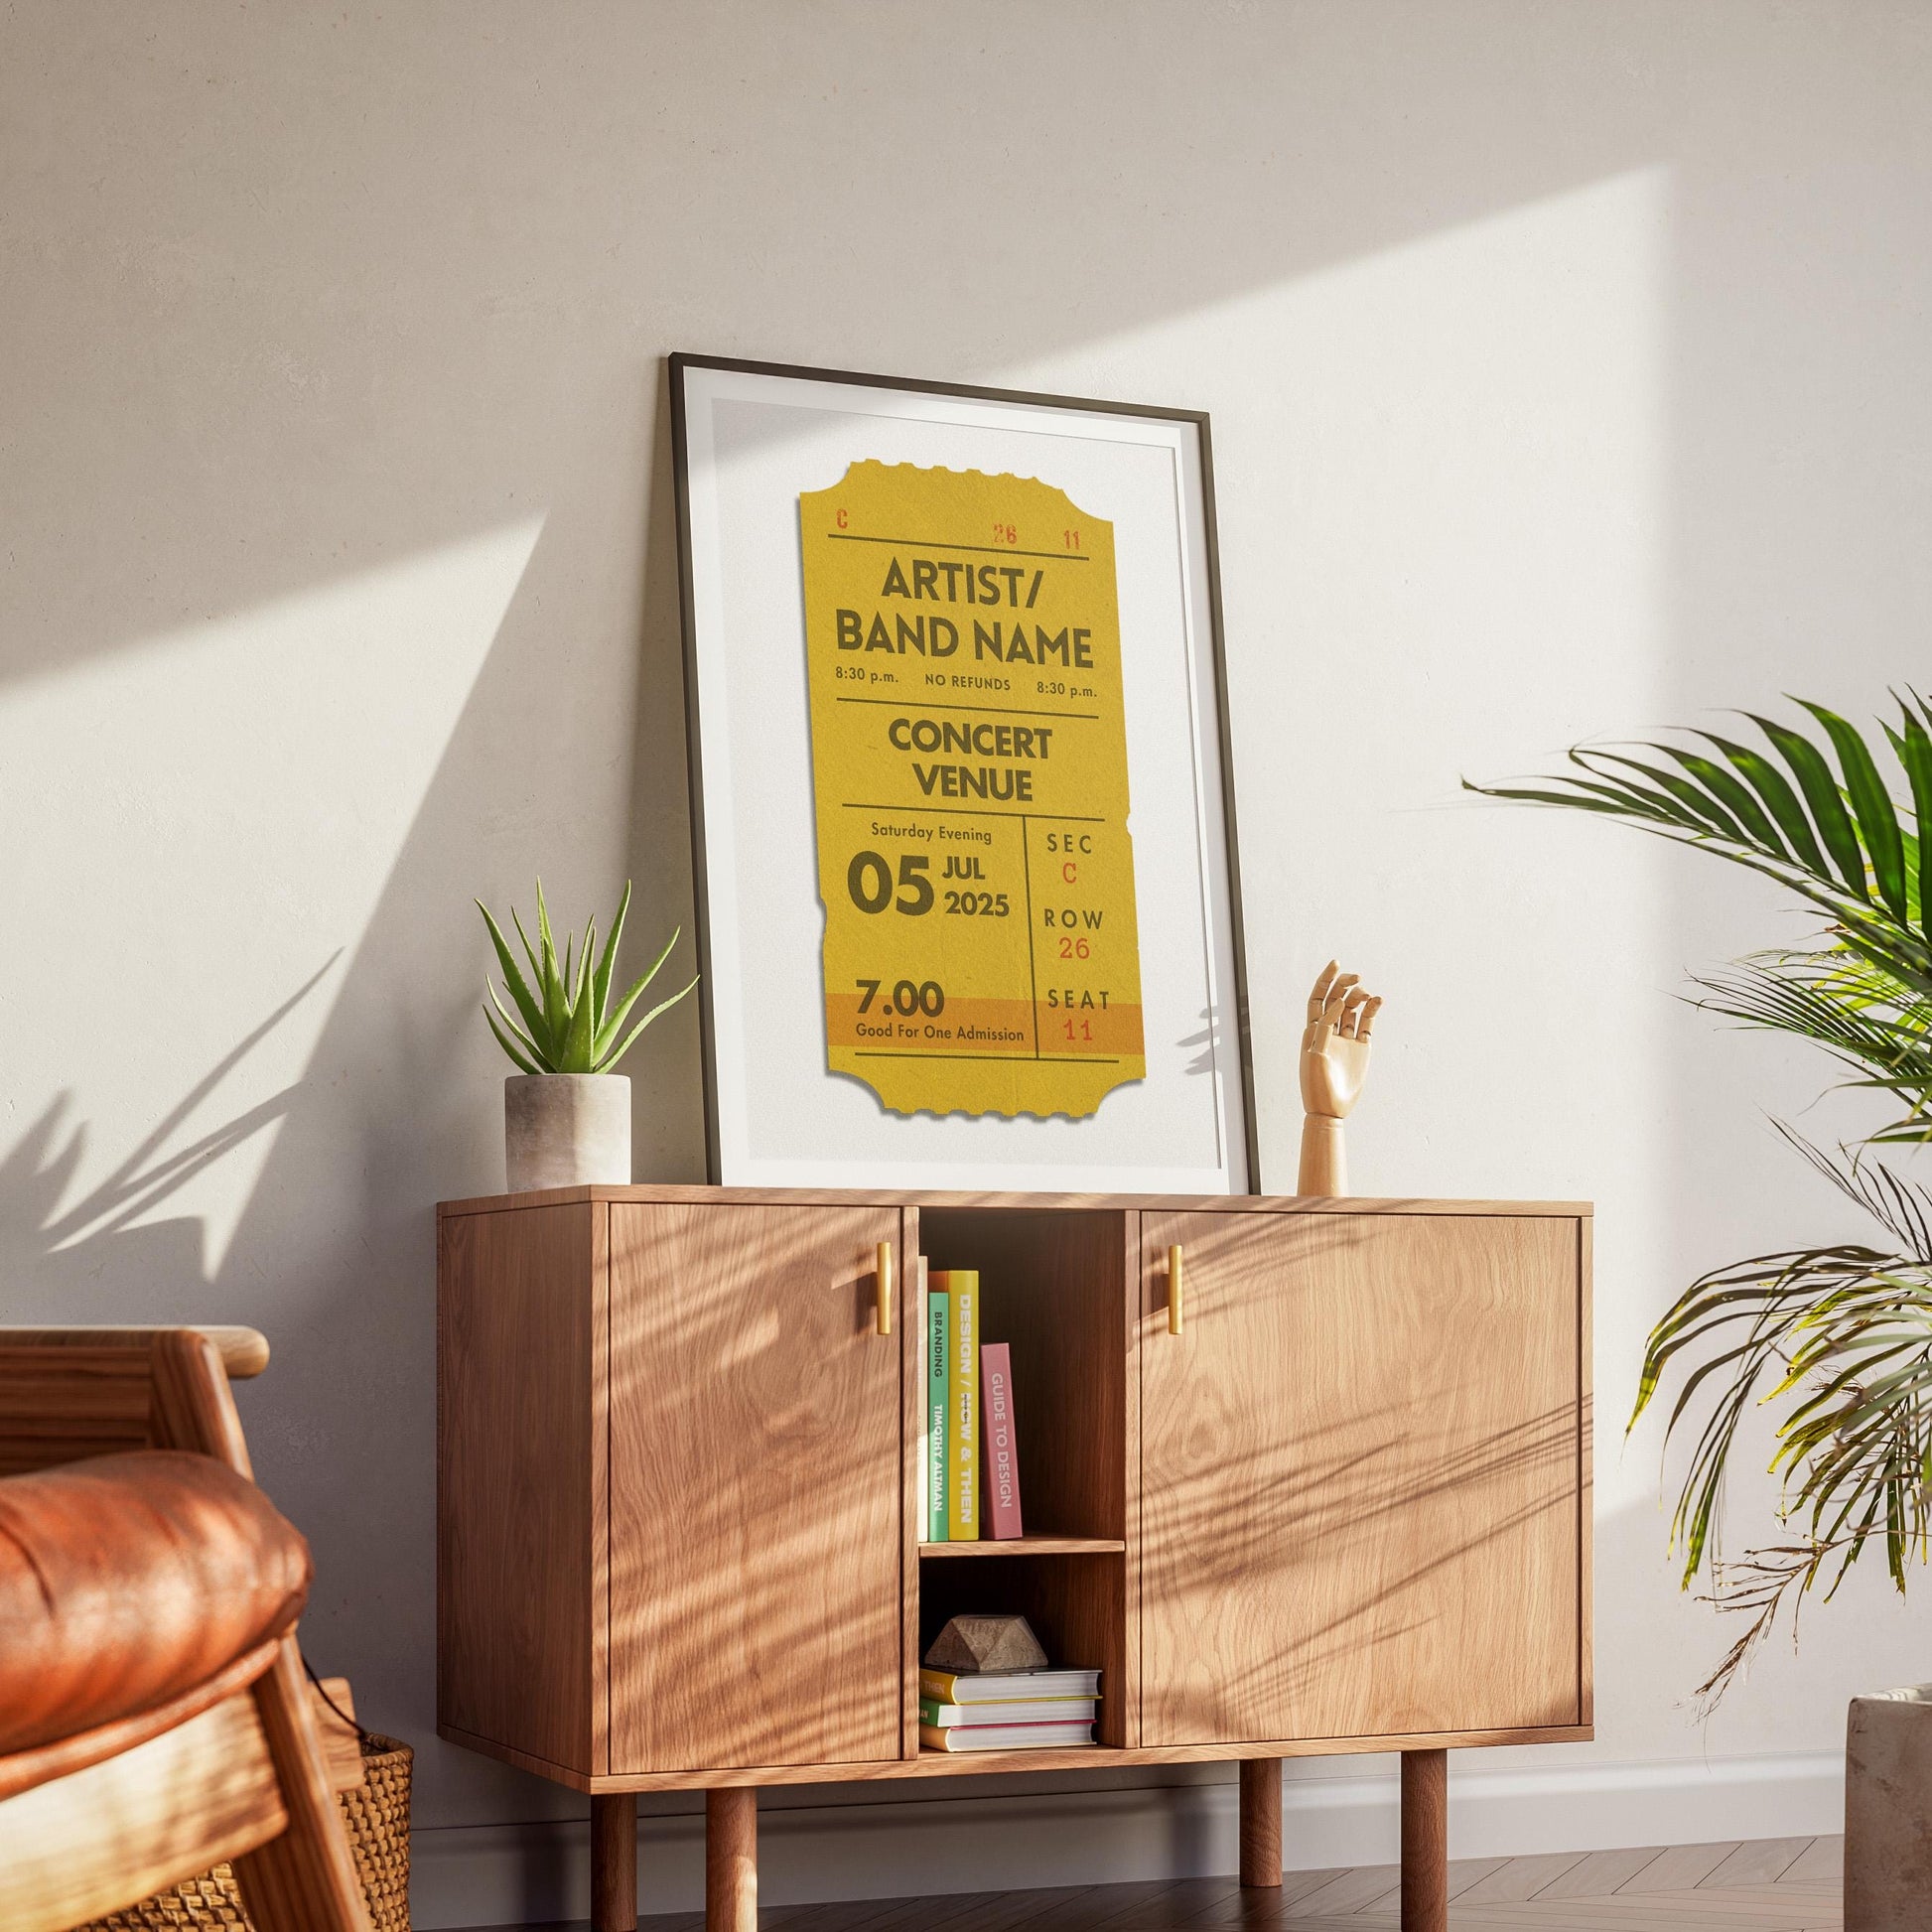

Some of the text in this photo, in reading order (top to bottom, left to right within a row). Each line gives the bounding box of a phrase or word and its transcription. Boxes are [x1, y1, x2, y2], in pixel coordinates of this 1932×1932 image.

[836, 508, 1080, 549] C 26 11
[881, 556, 1044, 609] ARTIST/
[836, 609, 1094, 668] BAND NAME
[835, 666, 1098, 700] 8:30 p.m. NO REFUNDS 8:30 p.m.
[889, 718, 1052, 759] CONCERT
[911, 762, 1033, 801] VENUE
[872, 822, 992, 845] Saturday Evening
[1047, 832, 1092, 854] SEC
[847, 850, 935, 916] 05
[942, 855, 986, 881] JUL
[1062, 862, 1077, 884] C
[944, 891, 1010, 917] 2025
[1044, 907, 1103, 930] ROW
[1058, 937, 1091, 960] 26
[855, 979, 945, 1018] 7.00
[1047, 989, 1110, 1010] SEAT
[856, 1023, 1025, 1042] Good For One Admission
[1062, 1019, 1093, 1041] 11
[960, 1294, 972, 1374] DESIGN
[934, 1311, 943, 1512] BRANDING TIMOTHY ALTMAN
[960, 1447, 972, 1462] &
[992, 1372, 1012, 1509] GUIDE TO DESIGN
[960, 1467, 972, 1524] THEN
